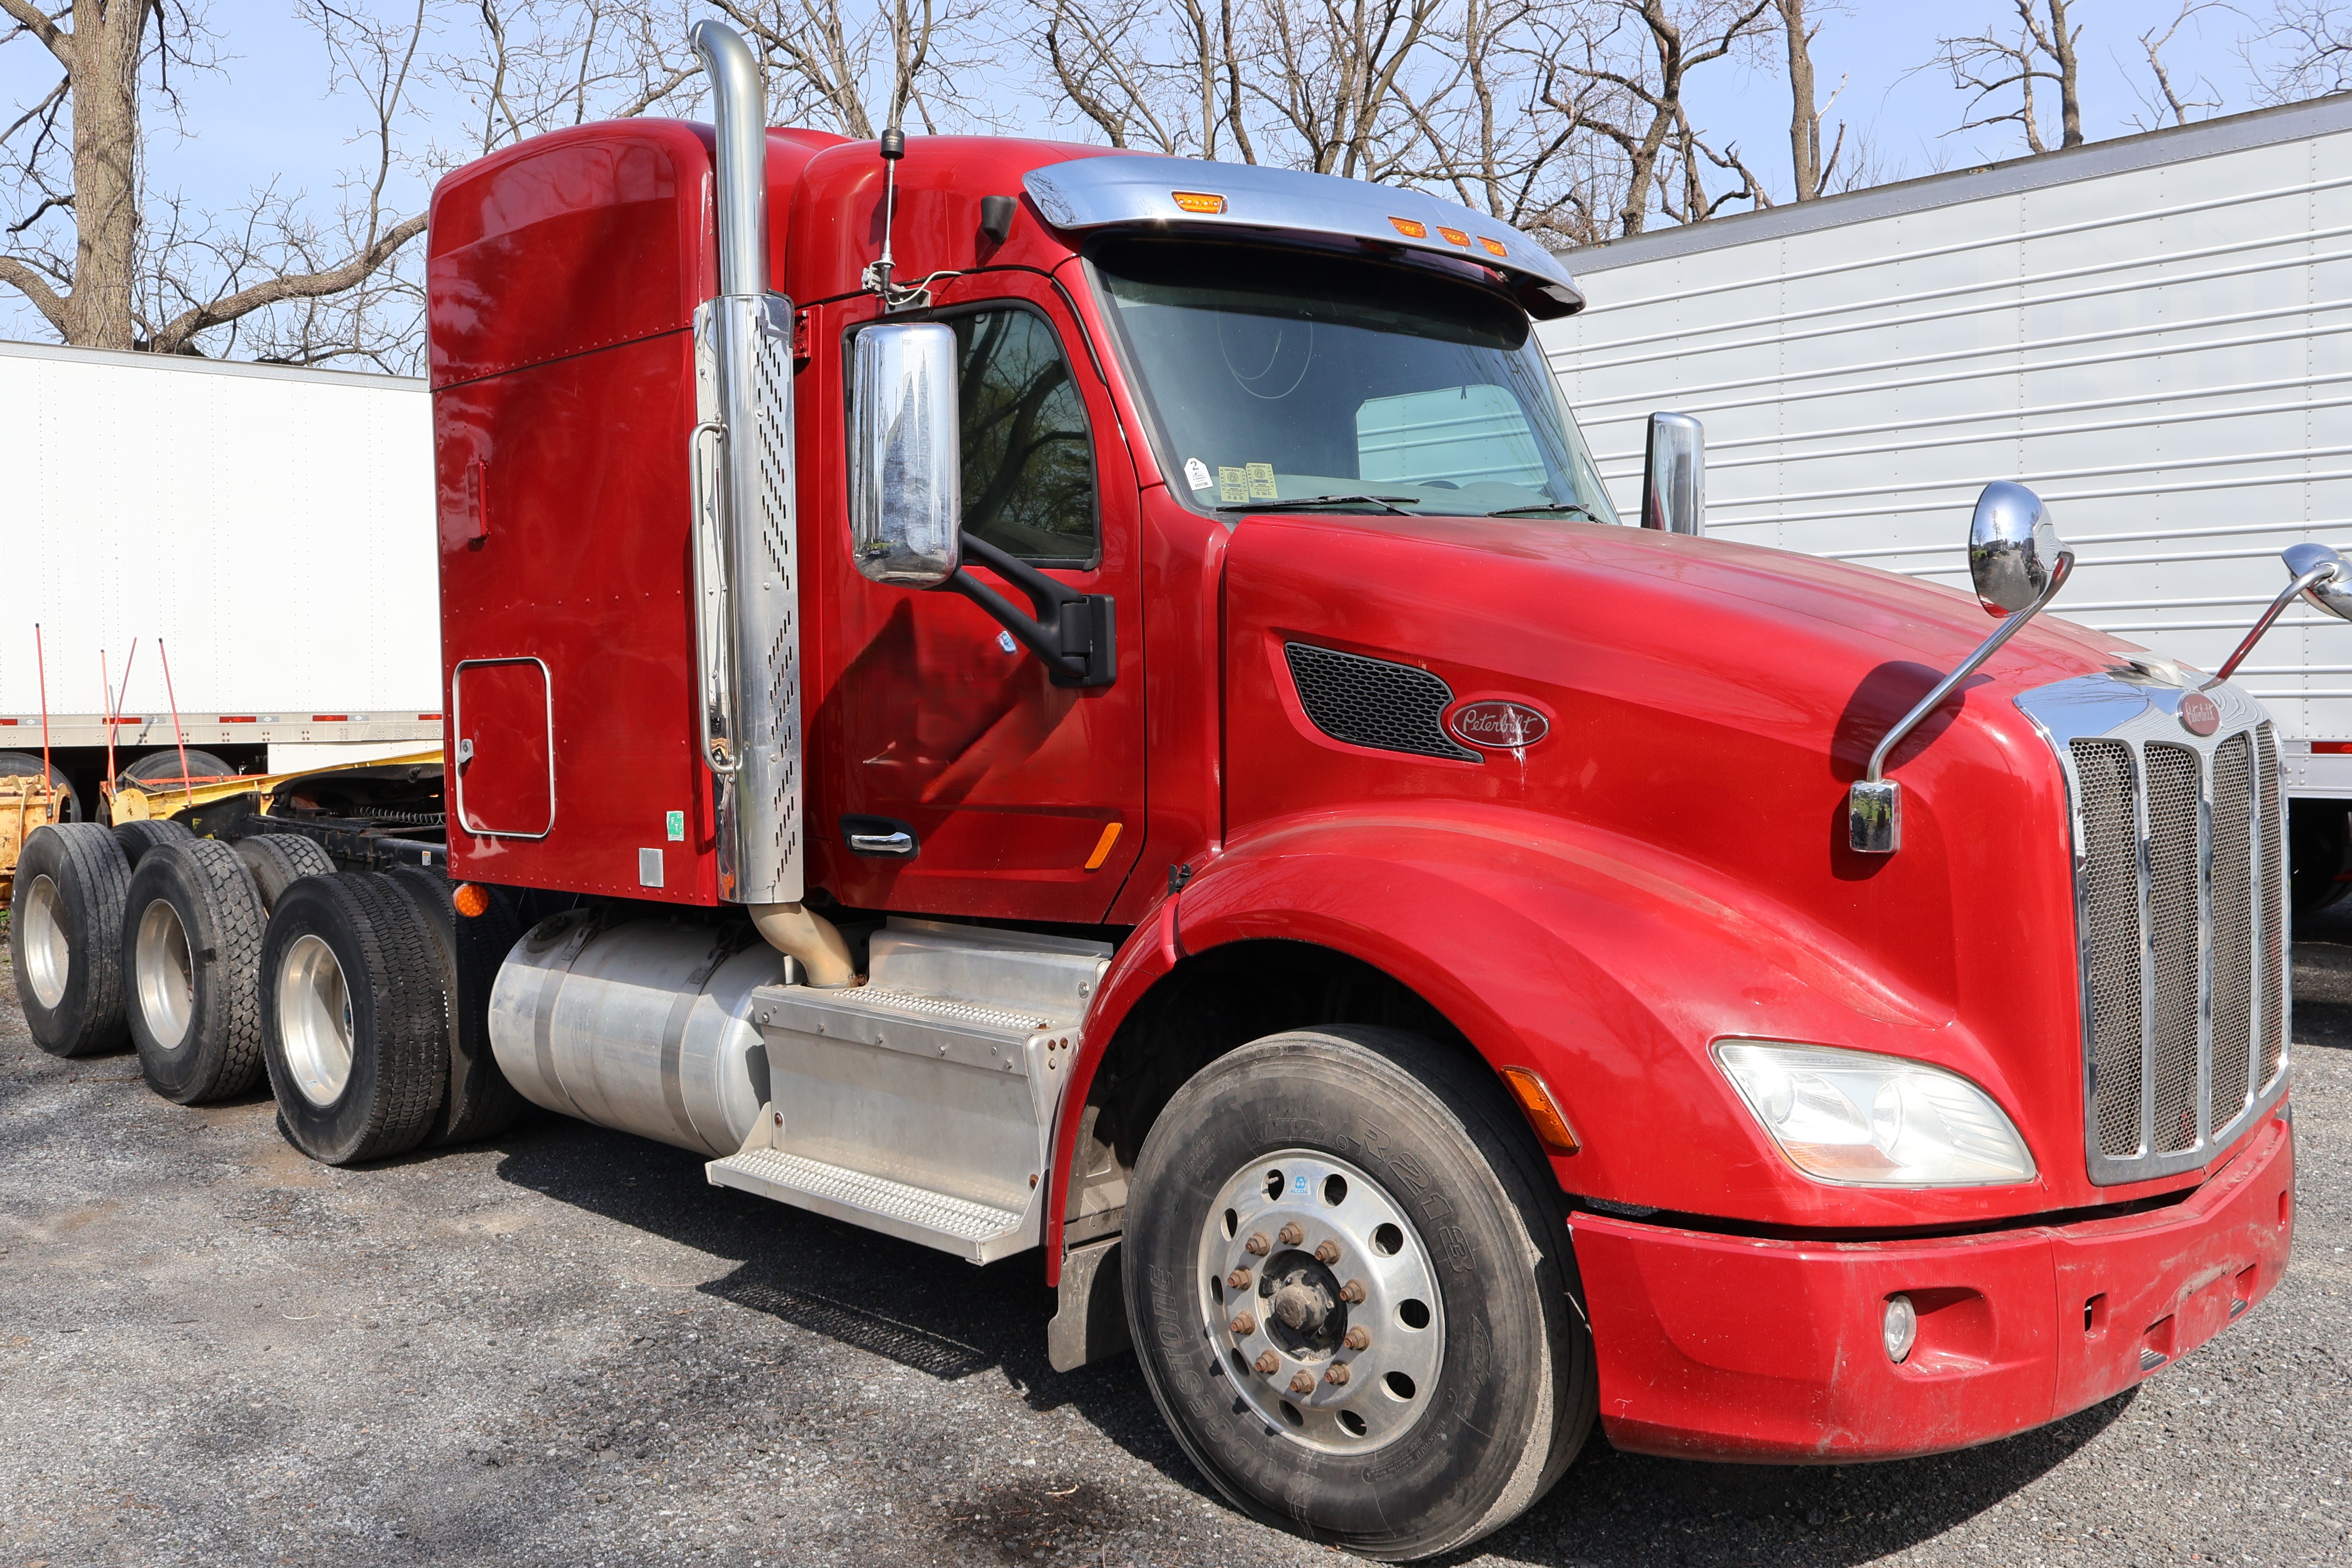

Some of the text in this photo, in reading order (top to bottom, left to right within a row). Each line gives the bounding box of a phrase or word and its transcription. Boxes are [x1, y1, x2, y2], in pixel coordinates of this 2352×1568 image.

[1190, 460, 1199, 470] 2
[1463, 709, 1538, 734] Peterbilt
[2185, 702, 2215, 726] Peterbilt
[1349, 1115, 1477, 1273] R213
[1148, 1264, 1322, 1508] BRIDGESTONE
